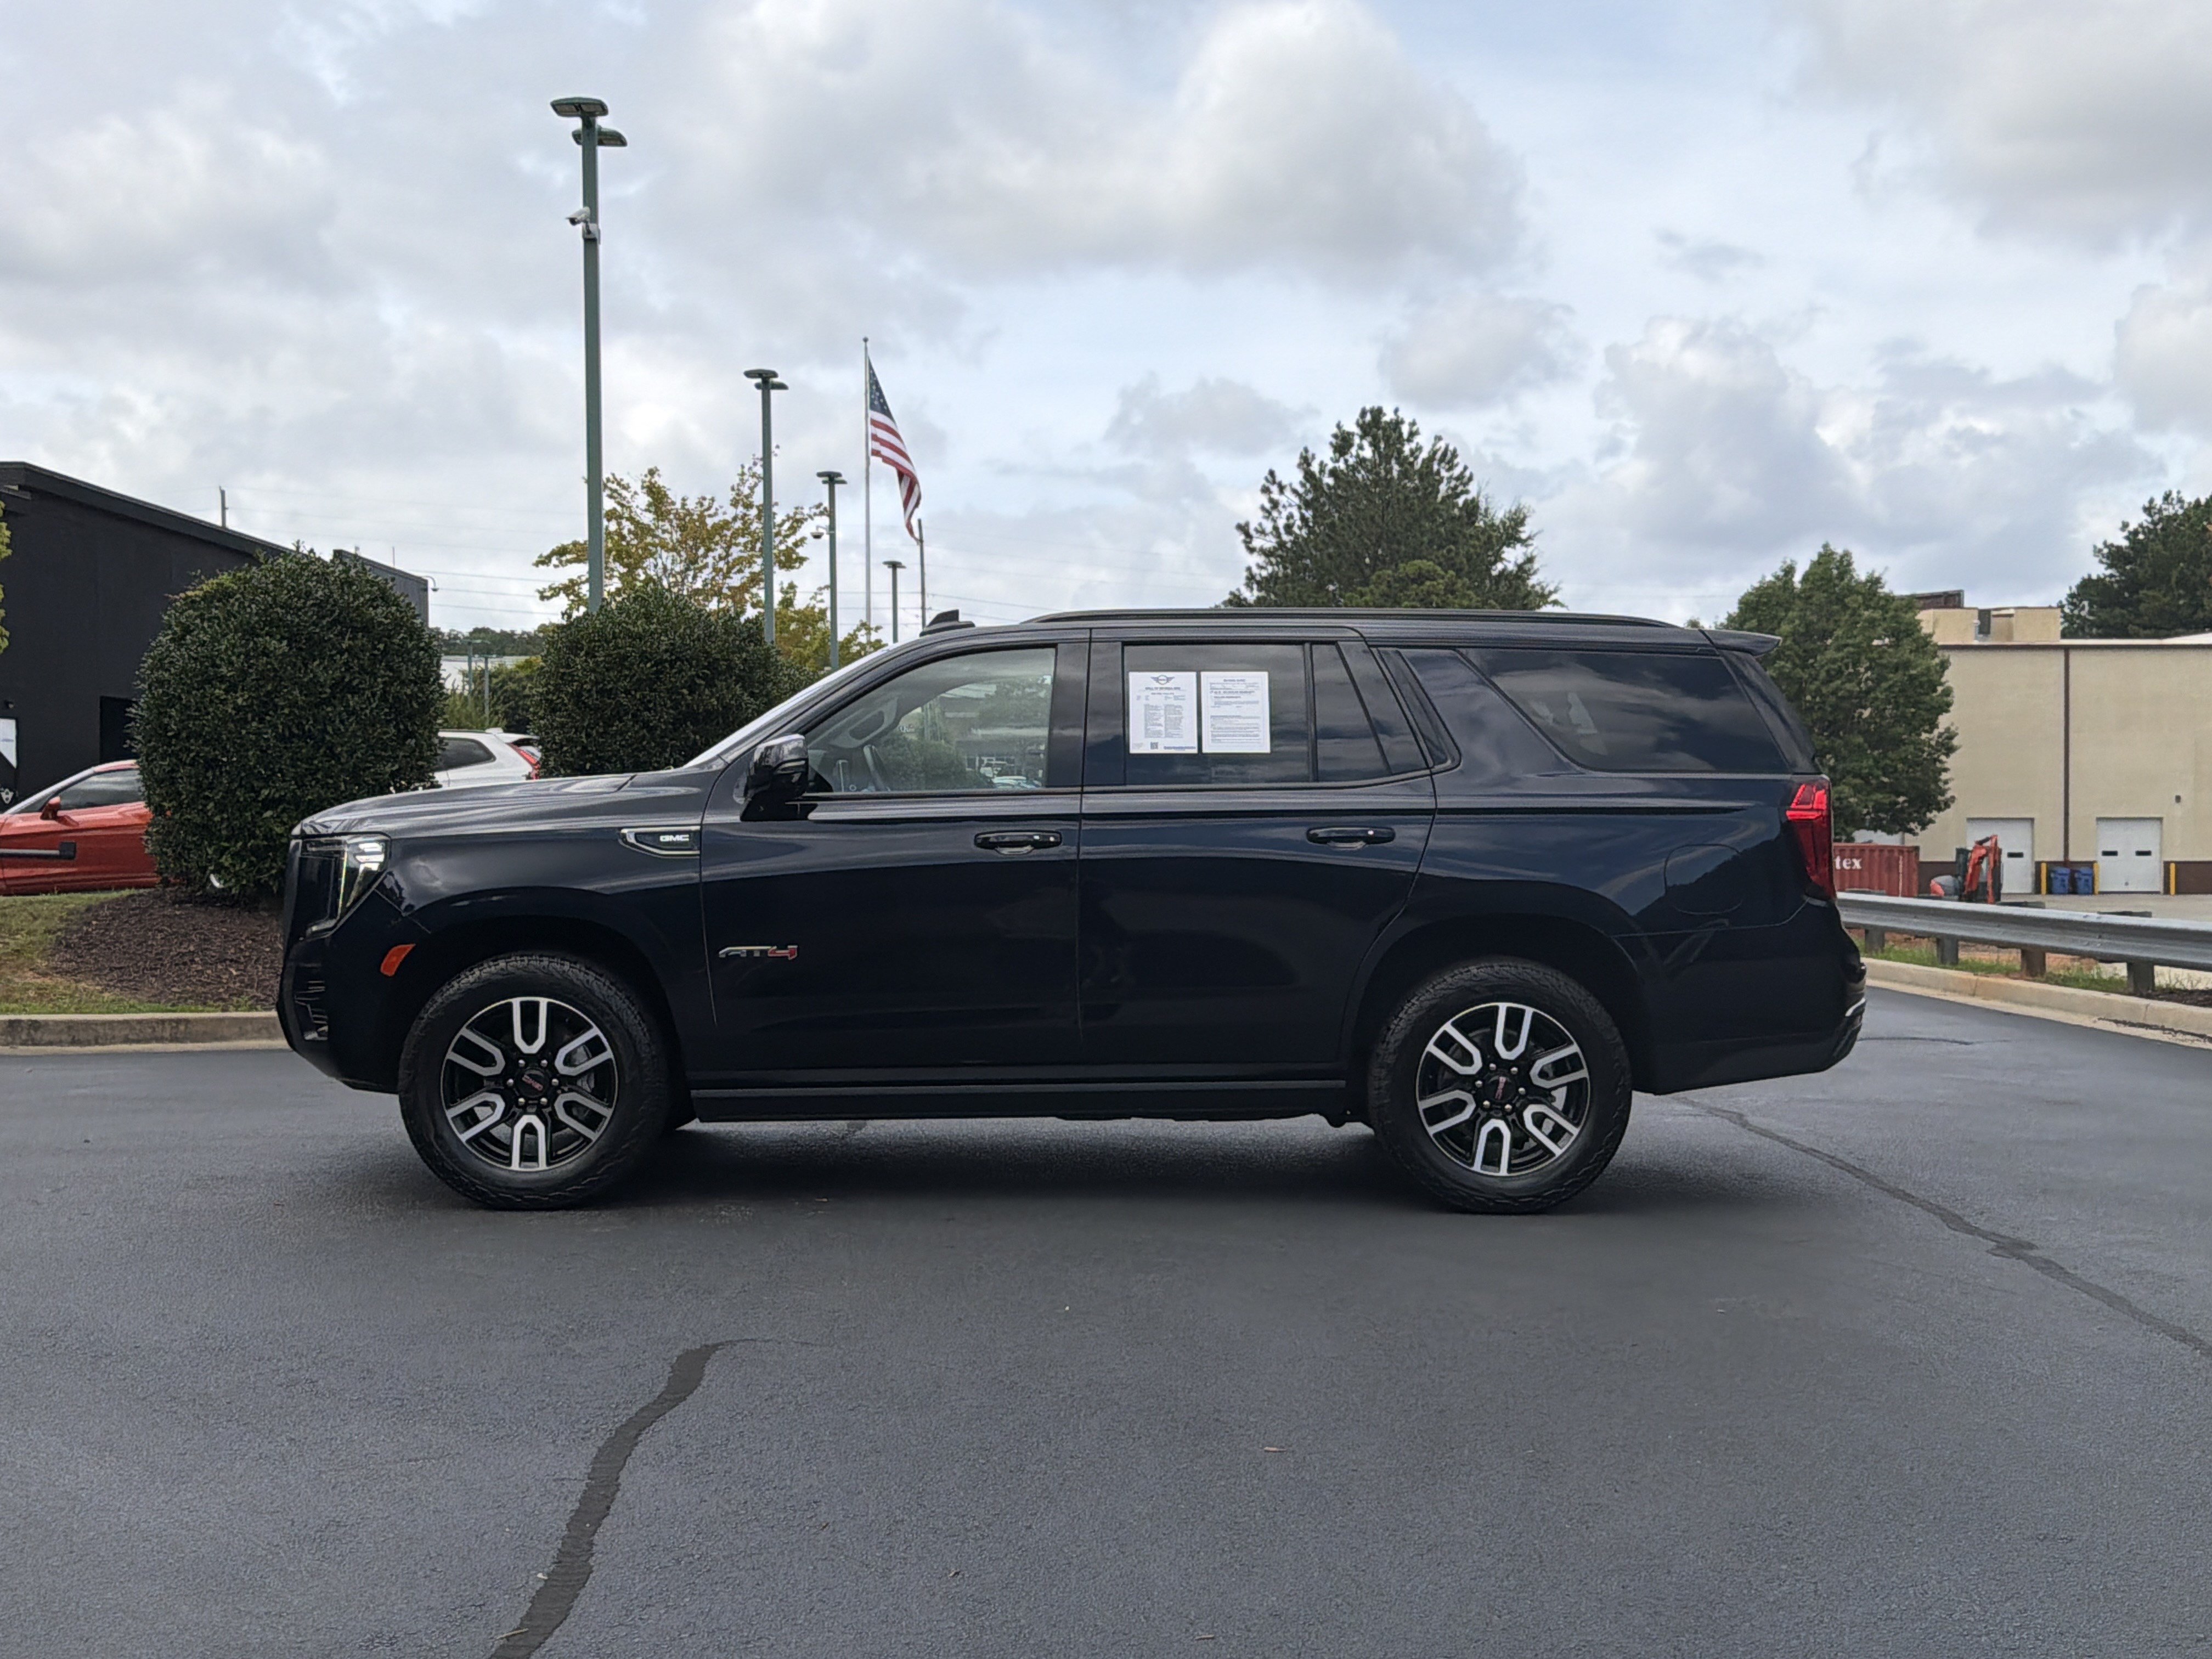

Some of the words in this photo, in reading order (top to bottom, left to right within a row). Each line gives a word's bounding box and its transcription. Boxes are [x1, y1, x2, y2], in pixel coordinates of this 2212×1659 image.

[659, 834, 690, 842] GMC
[1833, 855, 1863, 870] tex
[718, 945, 798, 960] AT4
